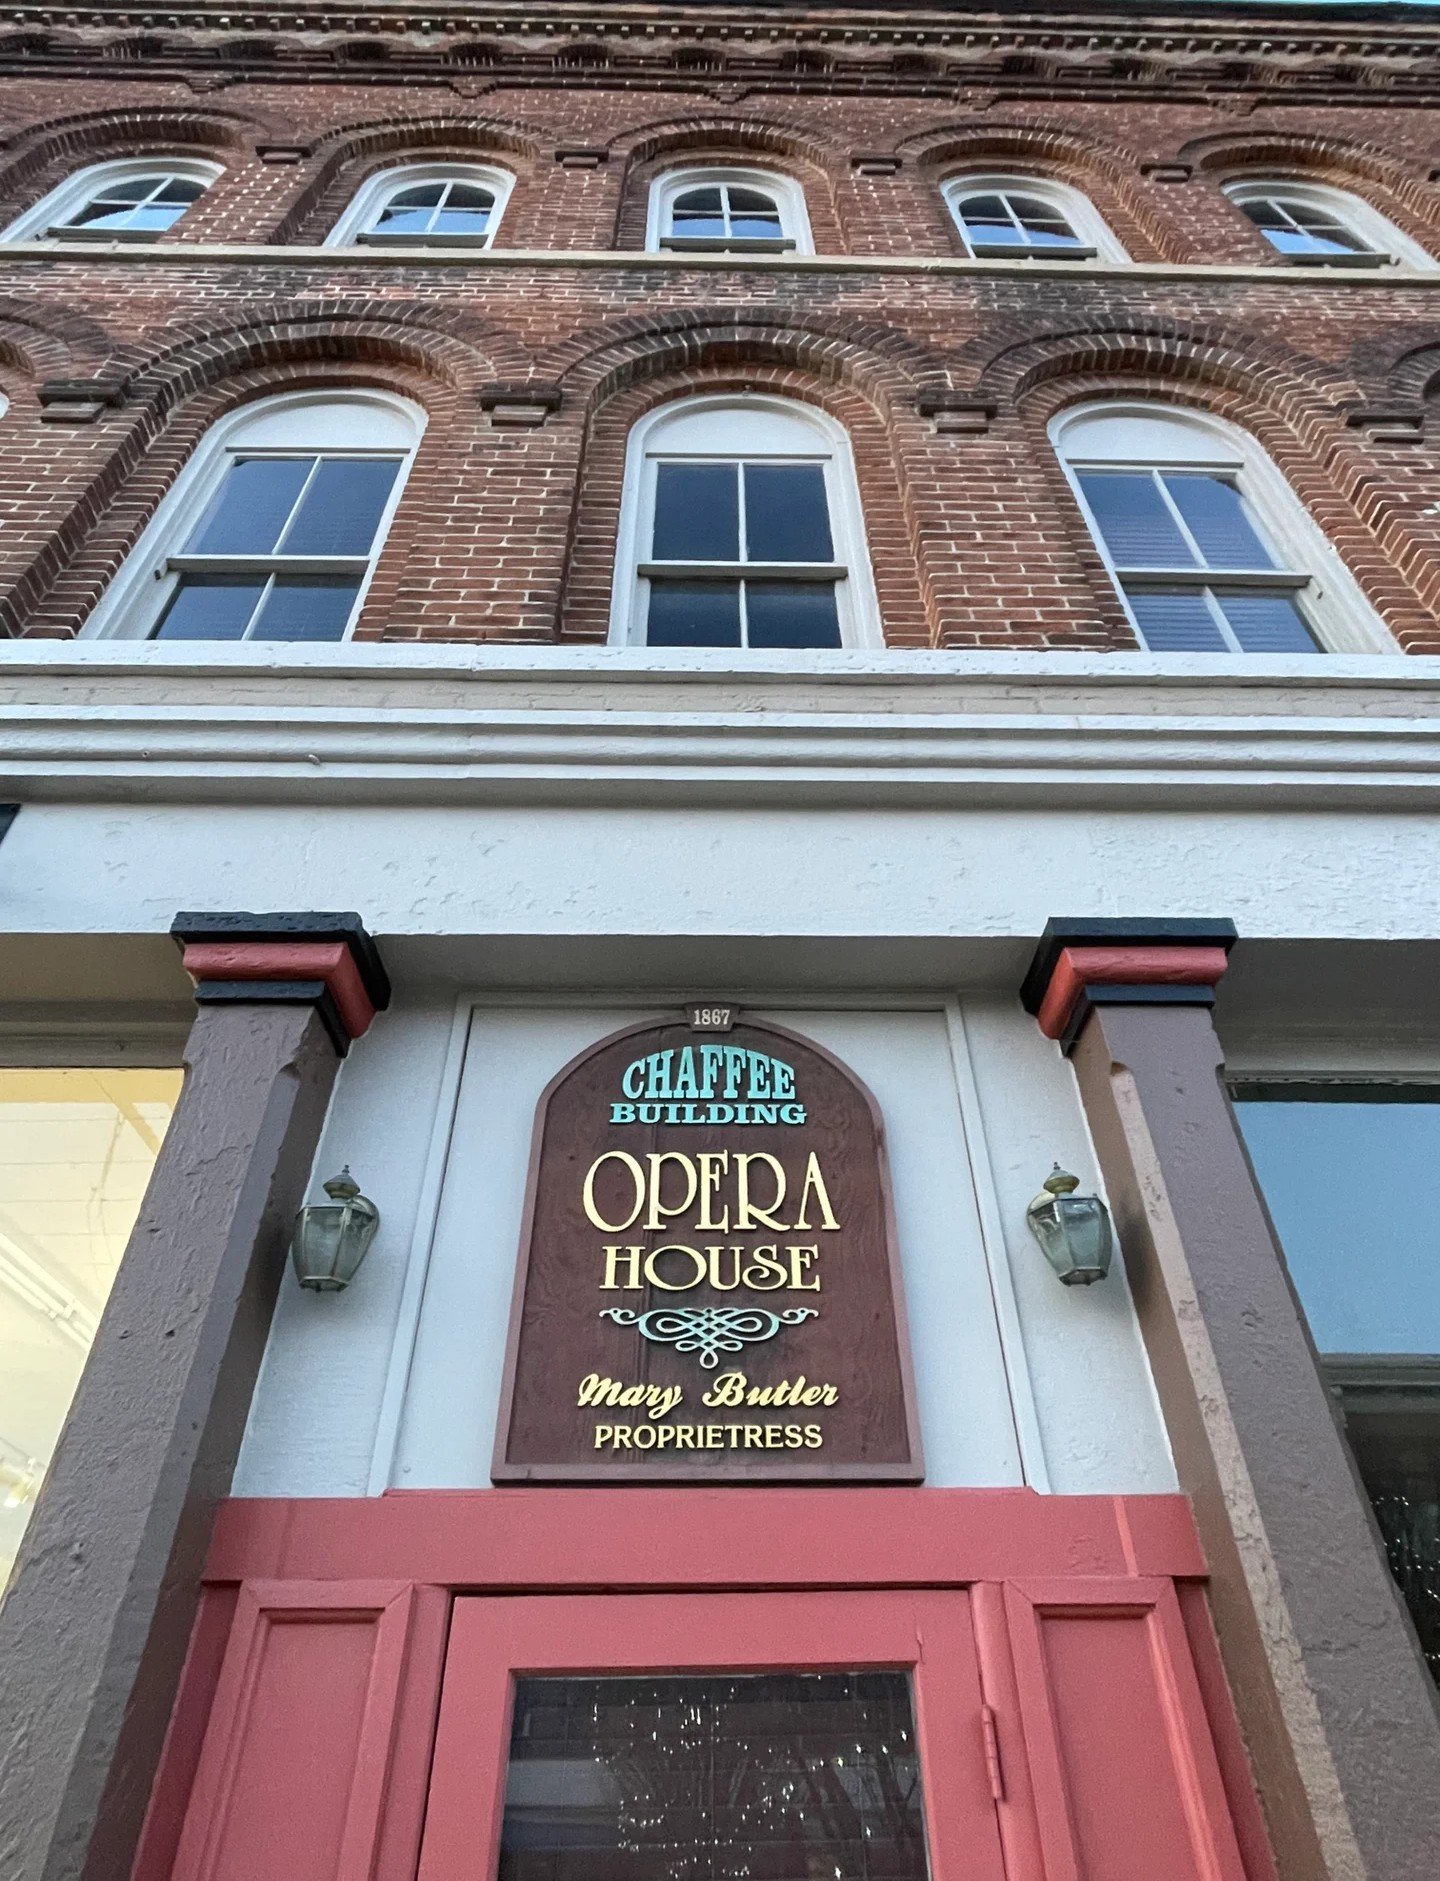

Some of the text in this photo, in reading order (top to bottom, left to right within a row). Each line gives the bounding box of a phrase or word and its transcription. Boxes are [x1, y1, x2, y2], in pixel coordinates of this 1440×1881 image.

[693, 1009, 730, 1025] 1867
[622, 1044, 796, 1100] CHAFFEE
[609, 1103, 807, 1125] BUILDING
[583, 1149, 841, 1234] OPERA
[599, 1244, 821, 1291] HOUSE
[578, 1371, 839, 1420] Mary Butler
[594, 1424, 823, 1449] PROPRIETRESS
